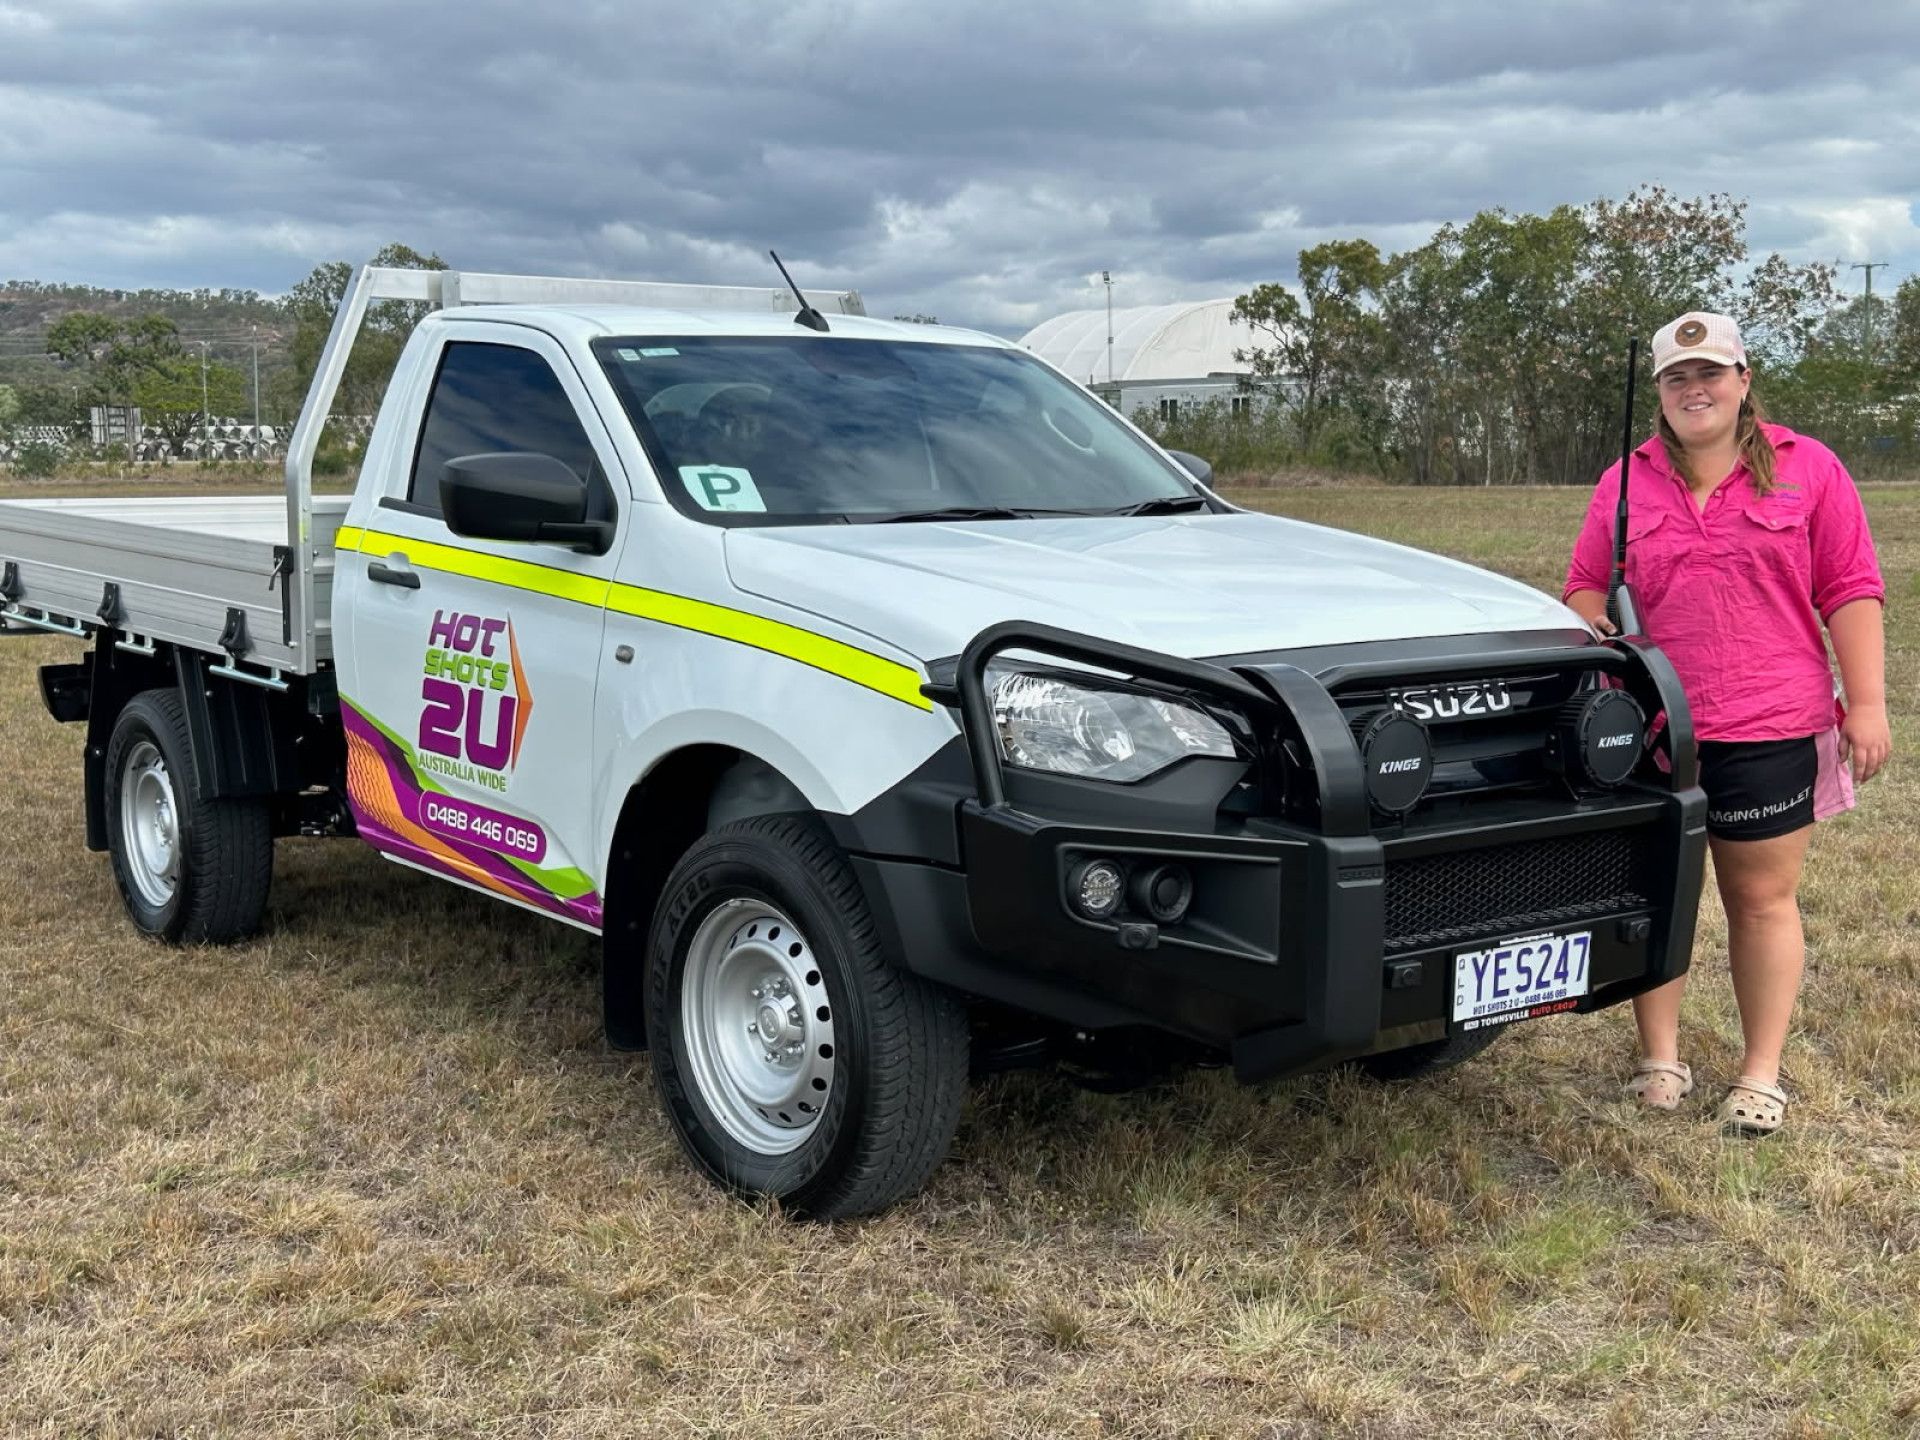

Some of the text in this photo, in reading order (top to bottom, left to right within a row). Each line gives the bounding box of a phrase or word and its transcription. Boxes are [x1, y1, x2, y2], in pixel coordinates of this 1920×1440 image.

[697, 472, 742, 507] P
[428, 609, 507, 657] HOT
[424, 649, 510, 691] SHOTS
[1390, 682, 1511, 720] ISUZU
[418, 677, 517, 771] 2U
[1597, 733, 1634, 749] KINGS
[418, 752, 507, 793] AUSTRALIA WIDE
[1379, 757, 1422, 774] KINGS
[1763, 785, 1812, 818] MULLET
[427, 803, 538, 853] 0488 446 069
[1471, 936, 1589, 1002] YES247
[1473, 1004, 1486, 1016] HOT
[1487, 1000, 1508, 1013] SHOTS
[1481, 1009, 1530, 1028] TOWNSVILLE
[1530, 1005, 1551, 1017] AUTO
[1553, 1000, 1579, 1013] GROUP
